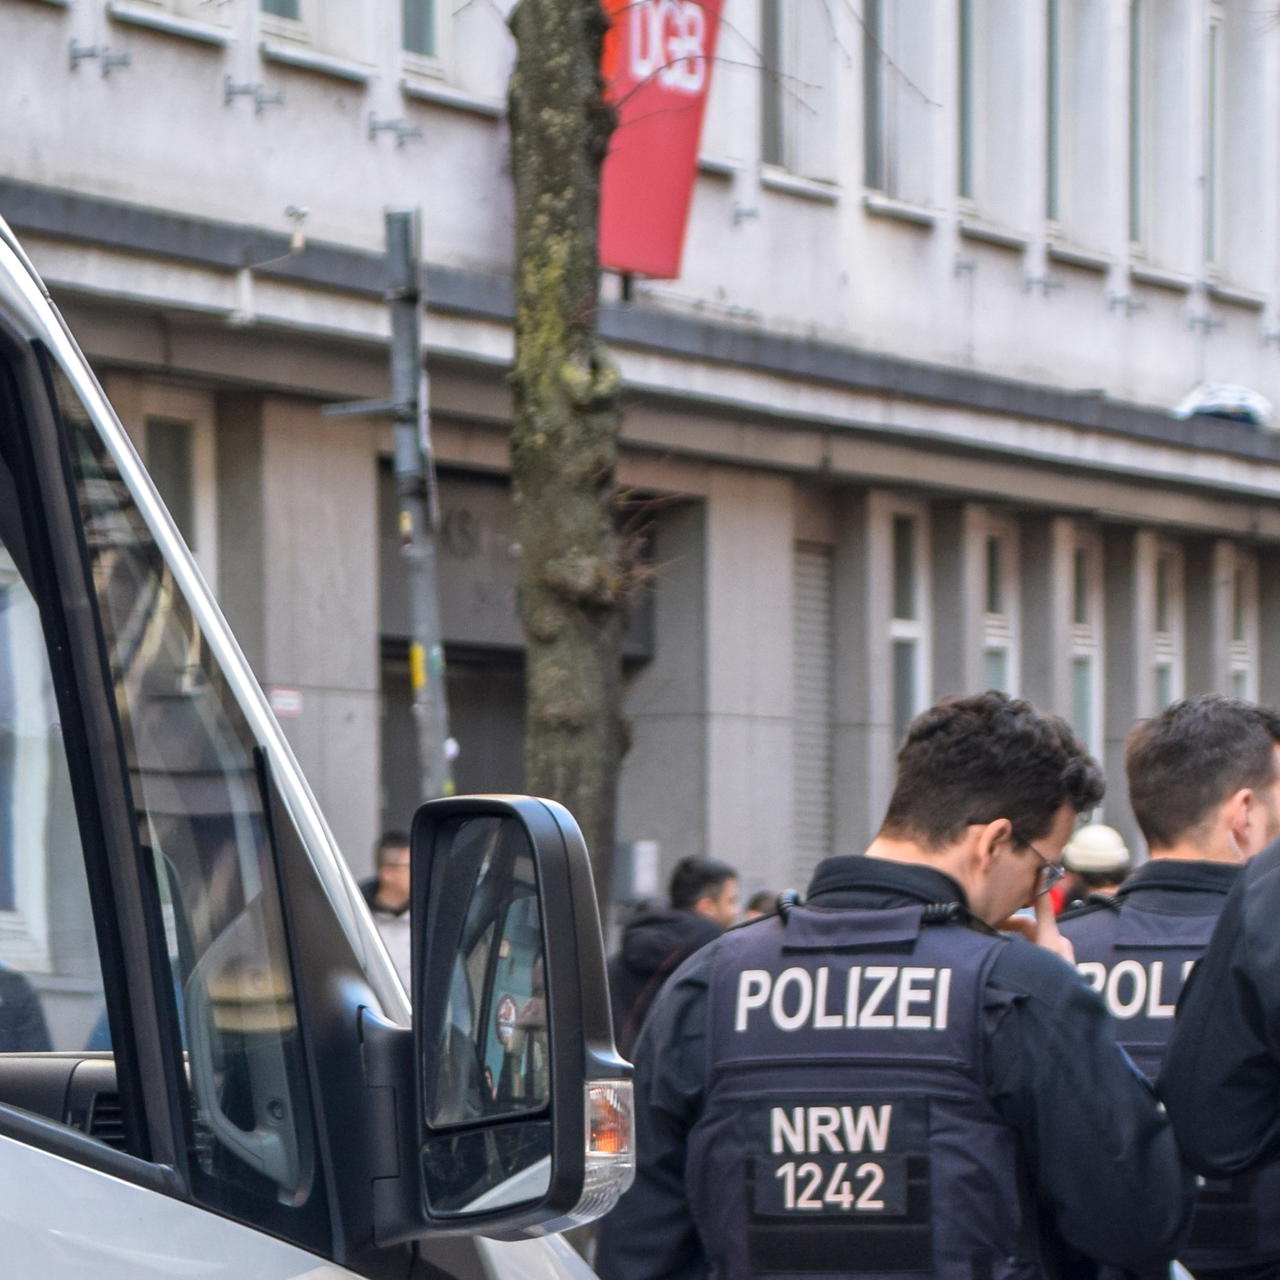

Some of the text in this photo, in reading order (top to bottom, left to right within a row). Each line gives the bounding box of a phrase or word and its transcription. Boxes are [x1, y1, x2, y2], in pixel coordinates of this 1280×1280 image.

[734, 965, 953, 1033] POLIZEI
[769, 1103, 893, 1155] NRW
[774, 1160, 886, 1211] 1242
